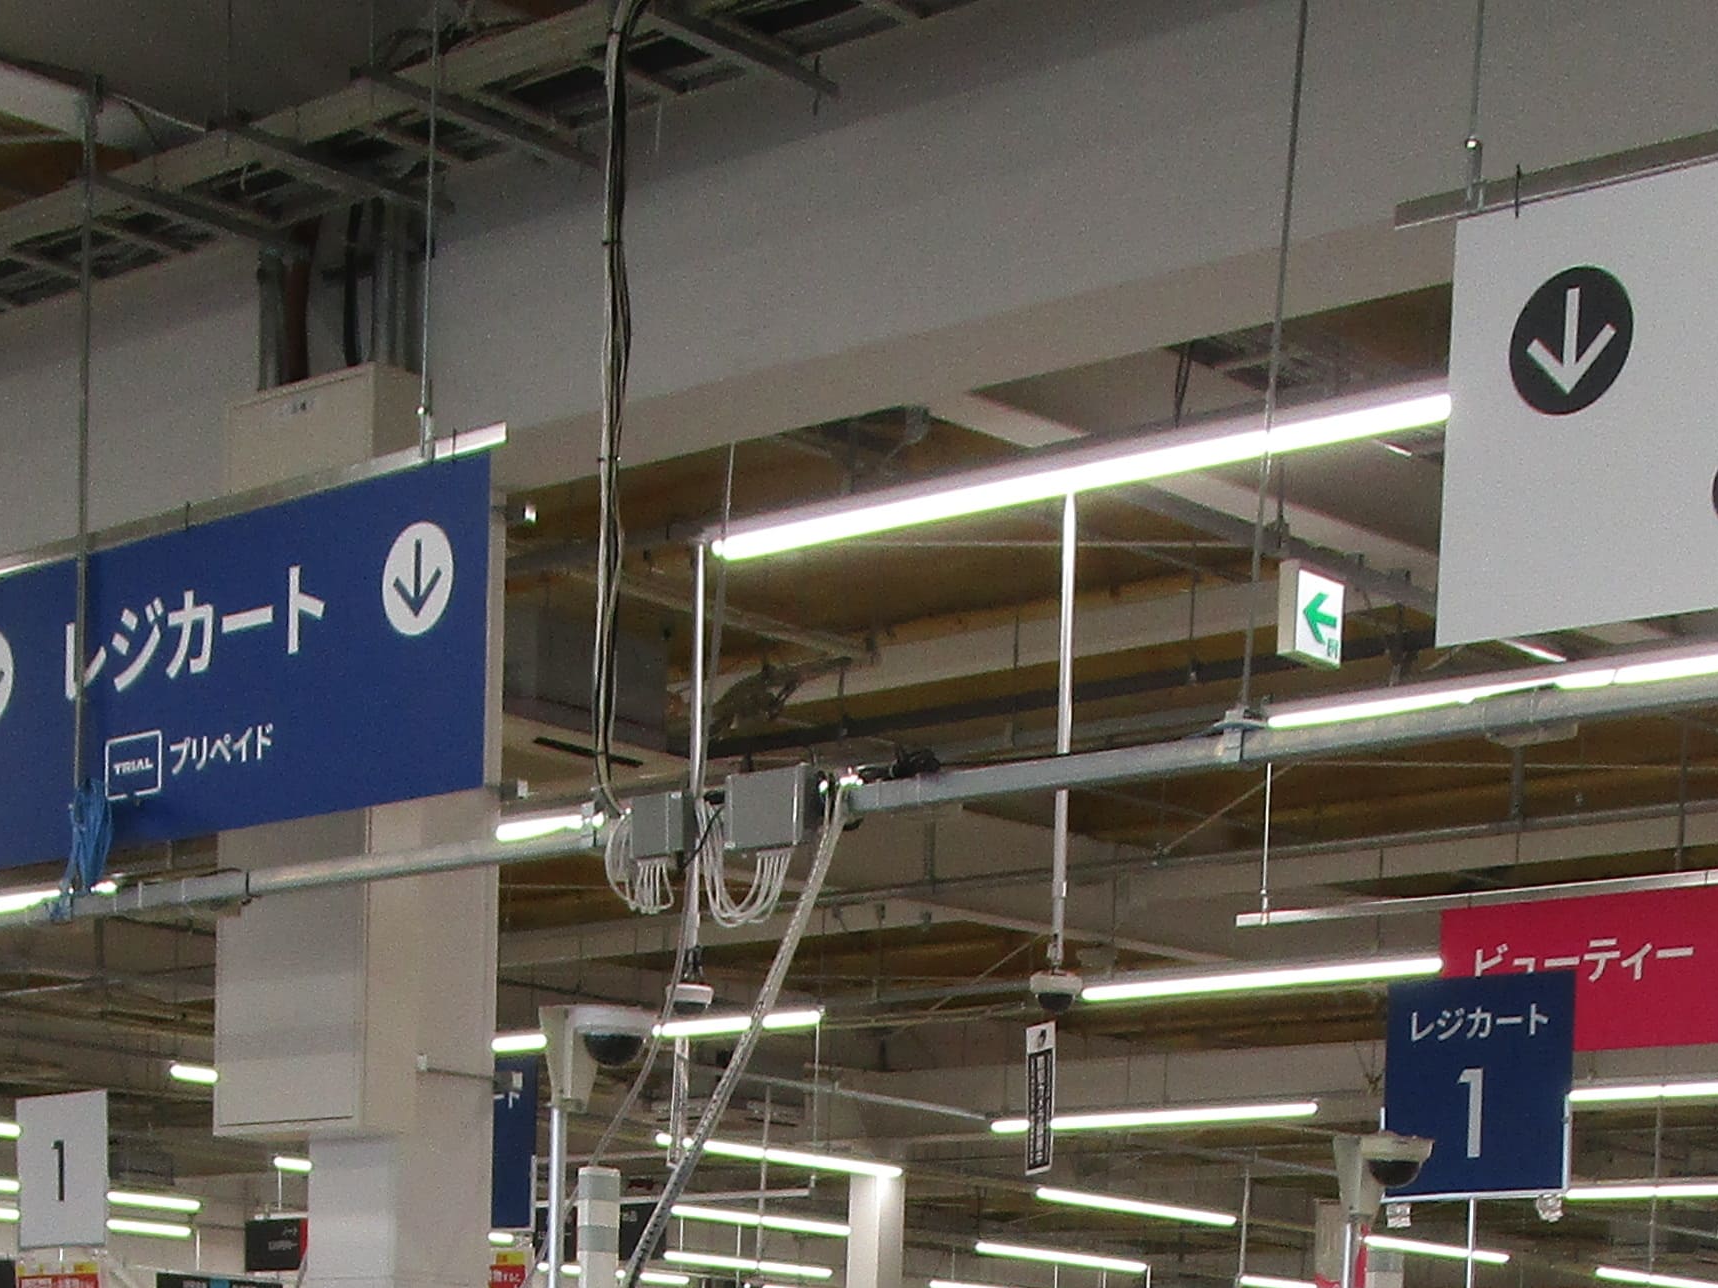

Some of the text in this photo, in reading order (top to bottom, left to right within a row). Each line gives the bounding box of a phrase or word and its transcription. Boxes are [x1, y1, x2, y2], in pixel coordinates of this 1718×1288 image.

[65, 565, 325, 700] レジカート
[113, 756, 153, 776] TRIAL
[169, 723, 274, 775] プリペイド
[1410, 1003, 1550, 1042] レジカート
[1458, 1067, 1484, 1159] 1
[52, 1140, 66, 1202] 1
